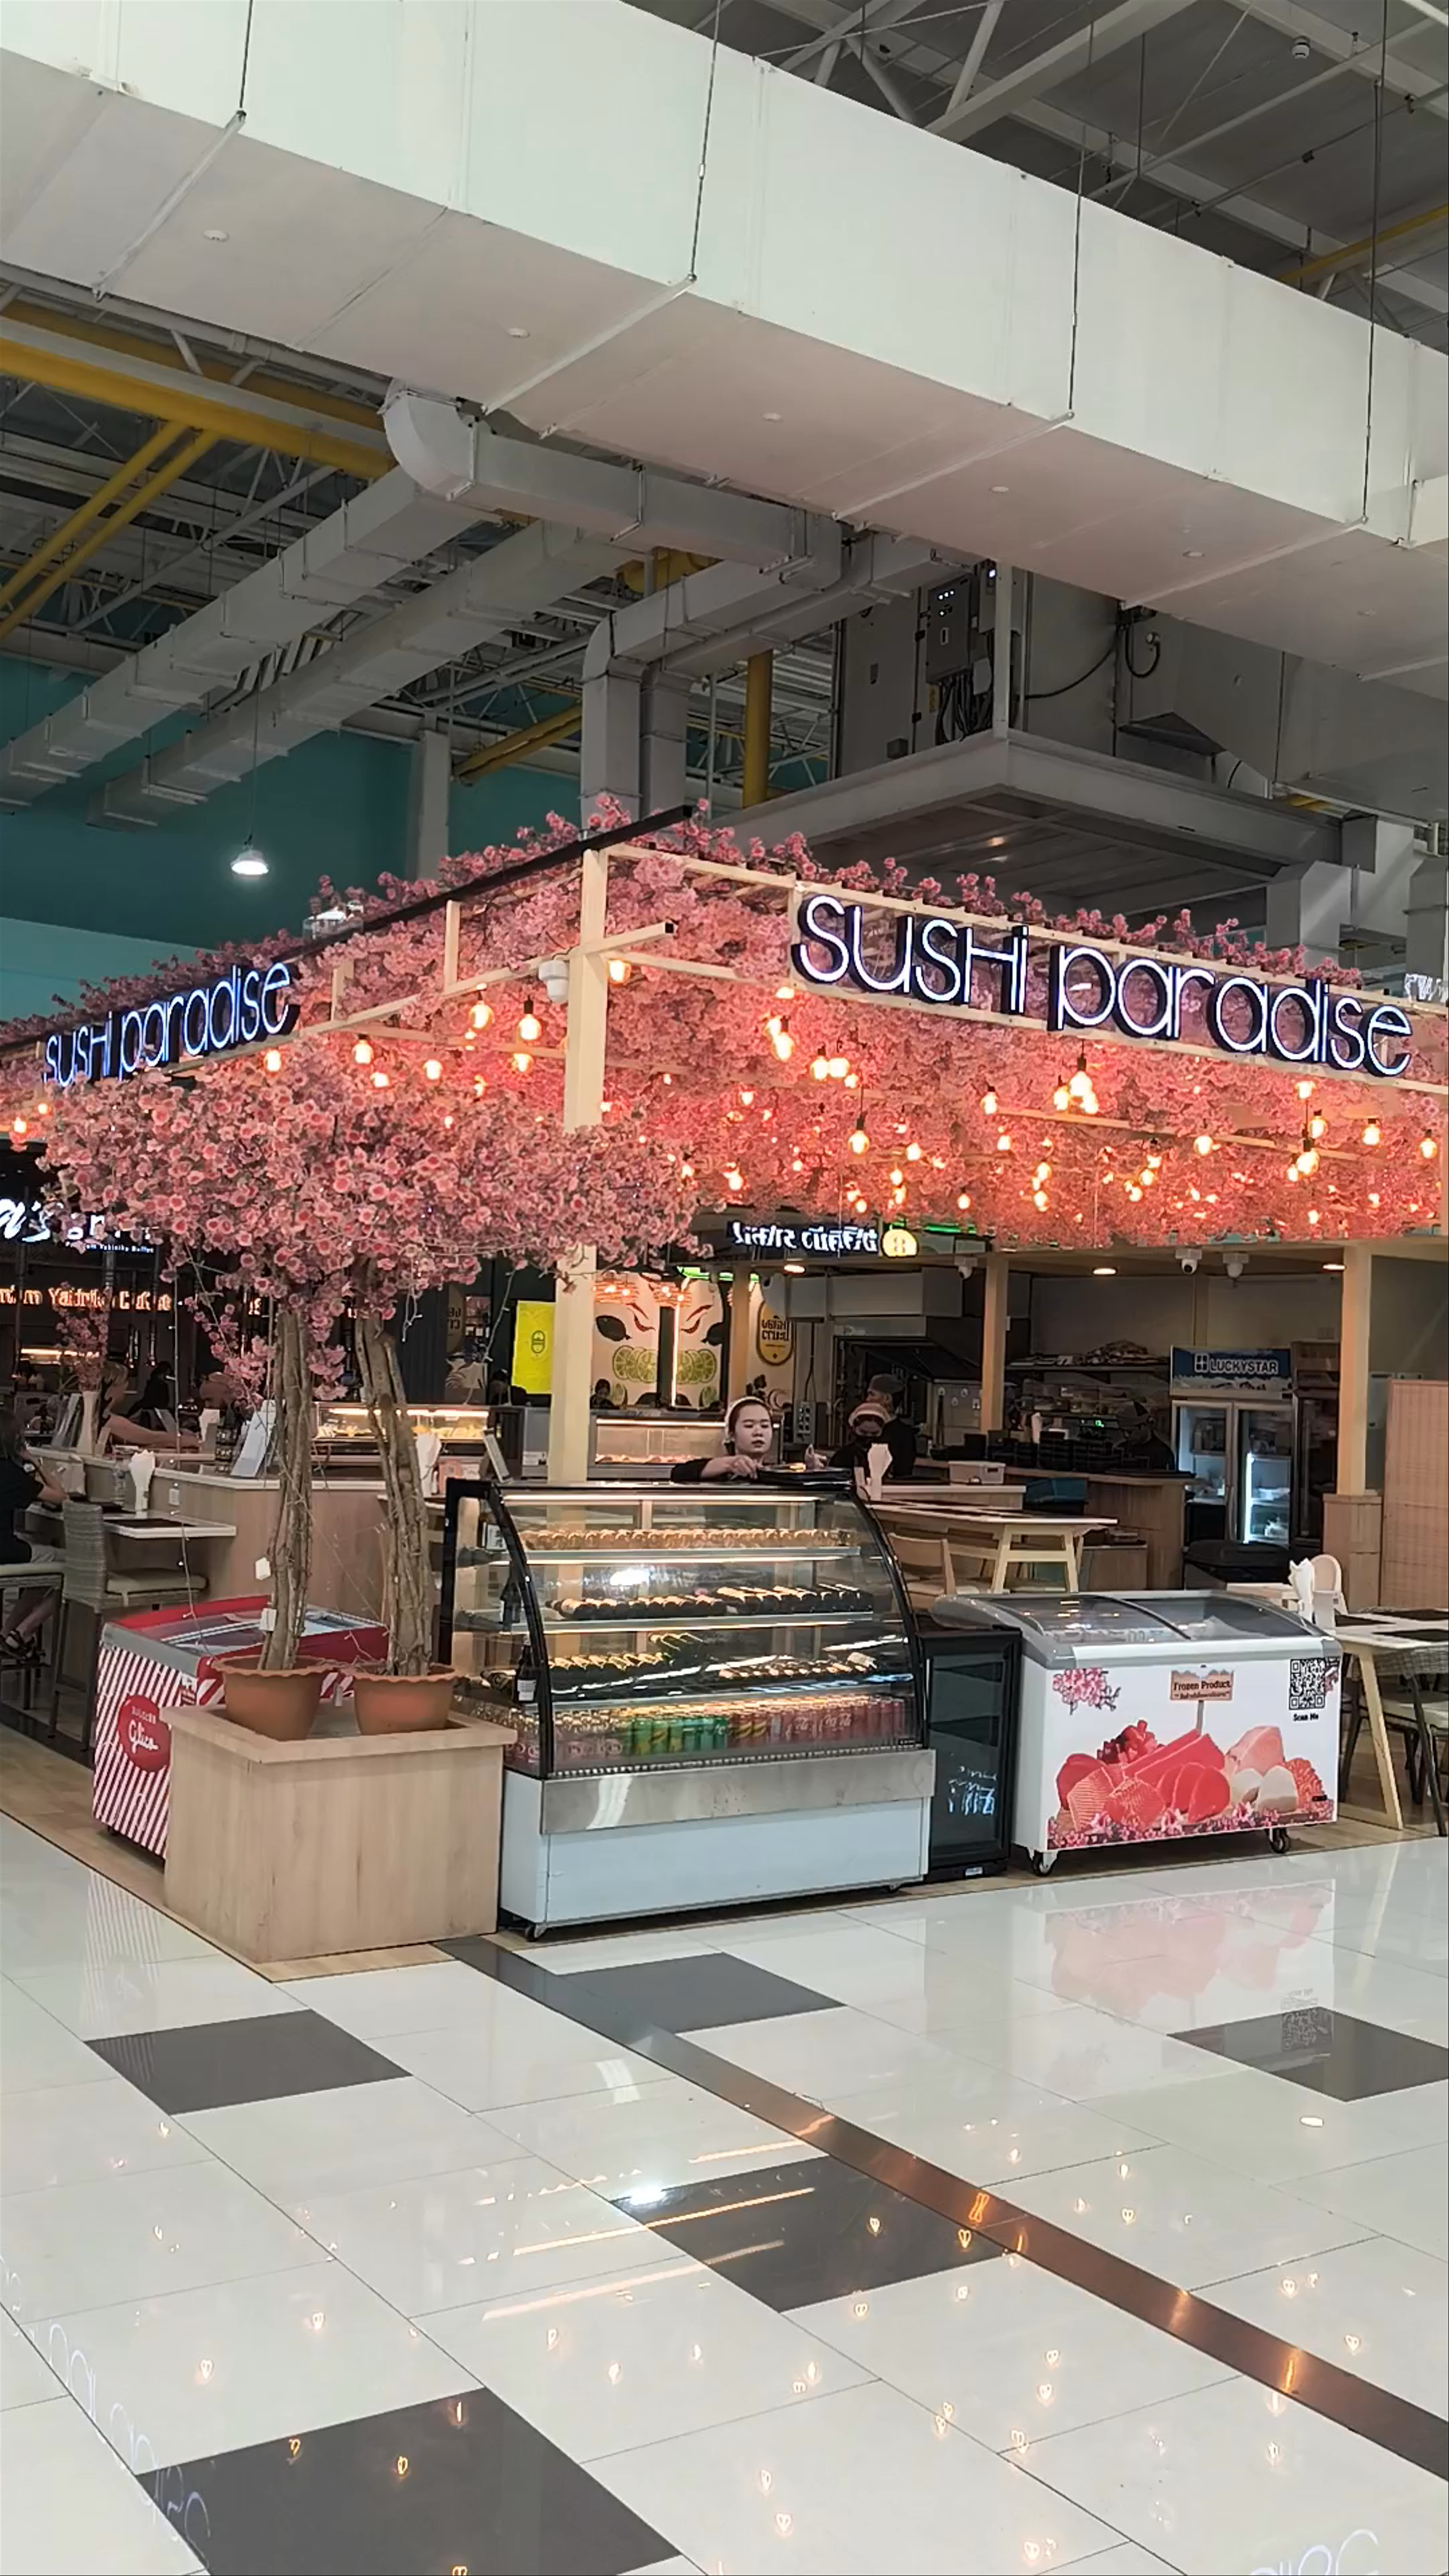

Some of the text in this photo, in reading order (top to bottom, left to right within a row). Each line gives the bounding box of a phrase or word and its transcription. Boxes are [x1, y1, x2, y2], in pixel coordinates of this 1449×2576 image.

[118, 962, 291, 1081] paradise
[1053, 945, 1412, 1076] paradise
[1210, 1358, 1278, 1374] LUCKYSTAR
[1174, 1680, 1231, 1690] Frozen Product
[129, 1719, 158, 1754] Glico
